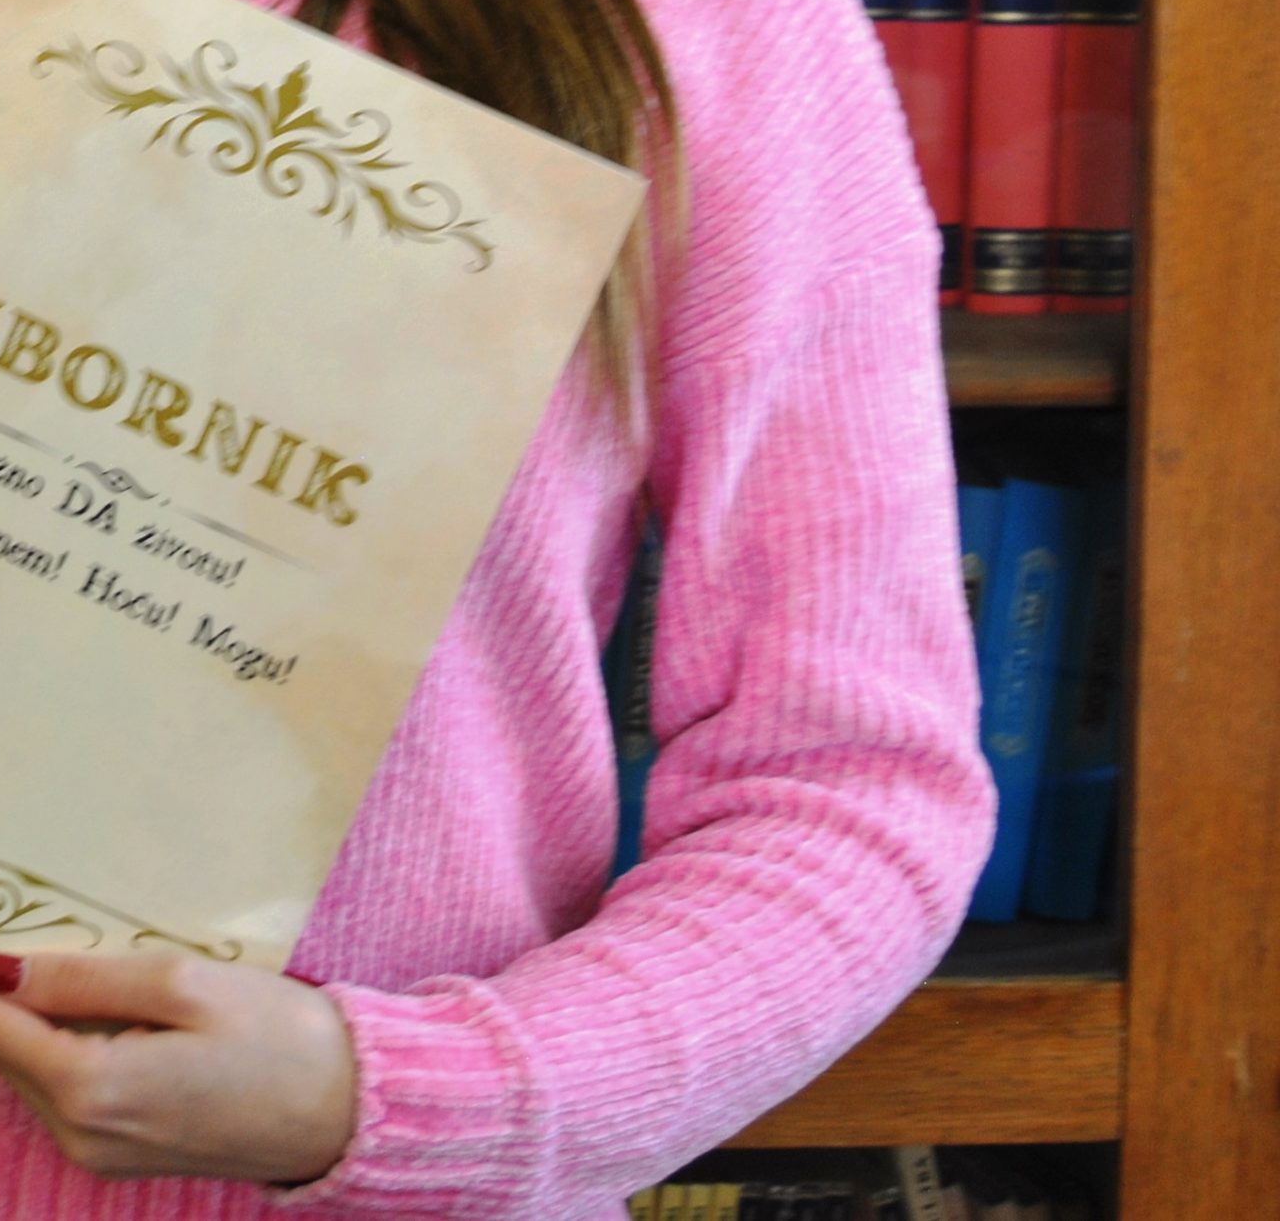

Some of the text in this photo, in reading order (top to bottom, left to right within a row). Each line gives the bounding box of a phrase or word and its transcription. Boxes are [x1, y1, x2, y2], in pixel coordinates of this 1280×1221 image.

[54, 480, 117, 535] DA
[131, 524, 247, 588] životu!
[75, 563, 182, 632] Hoću!
[189, 613, 299, 685] Mogu!
